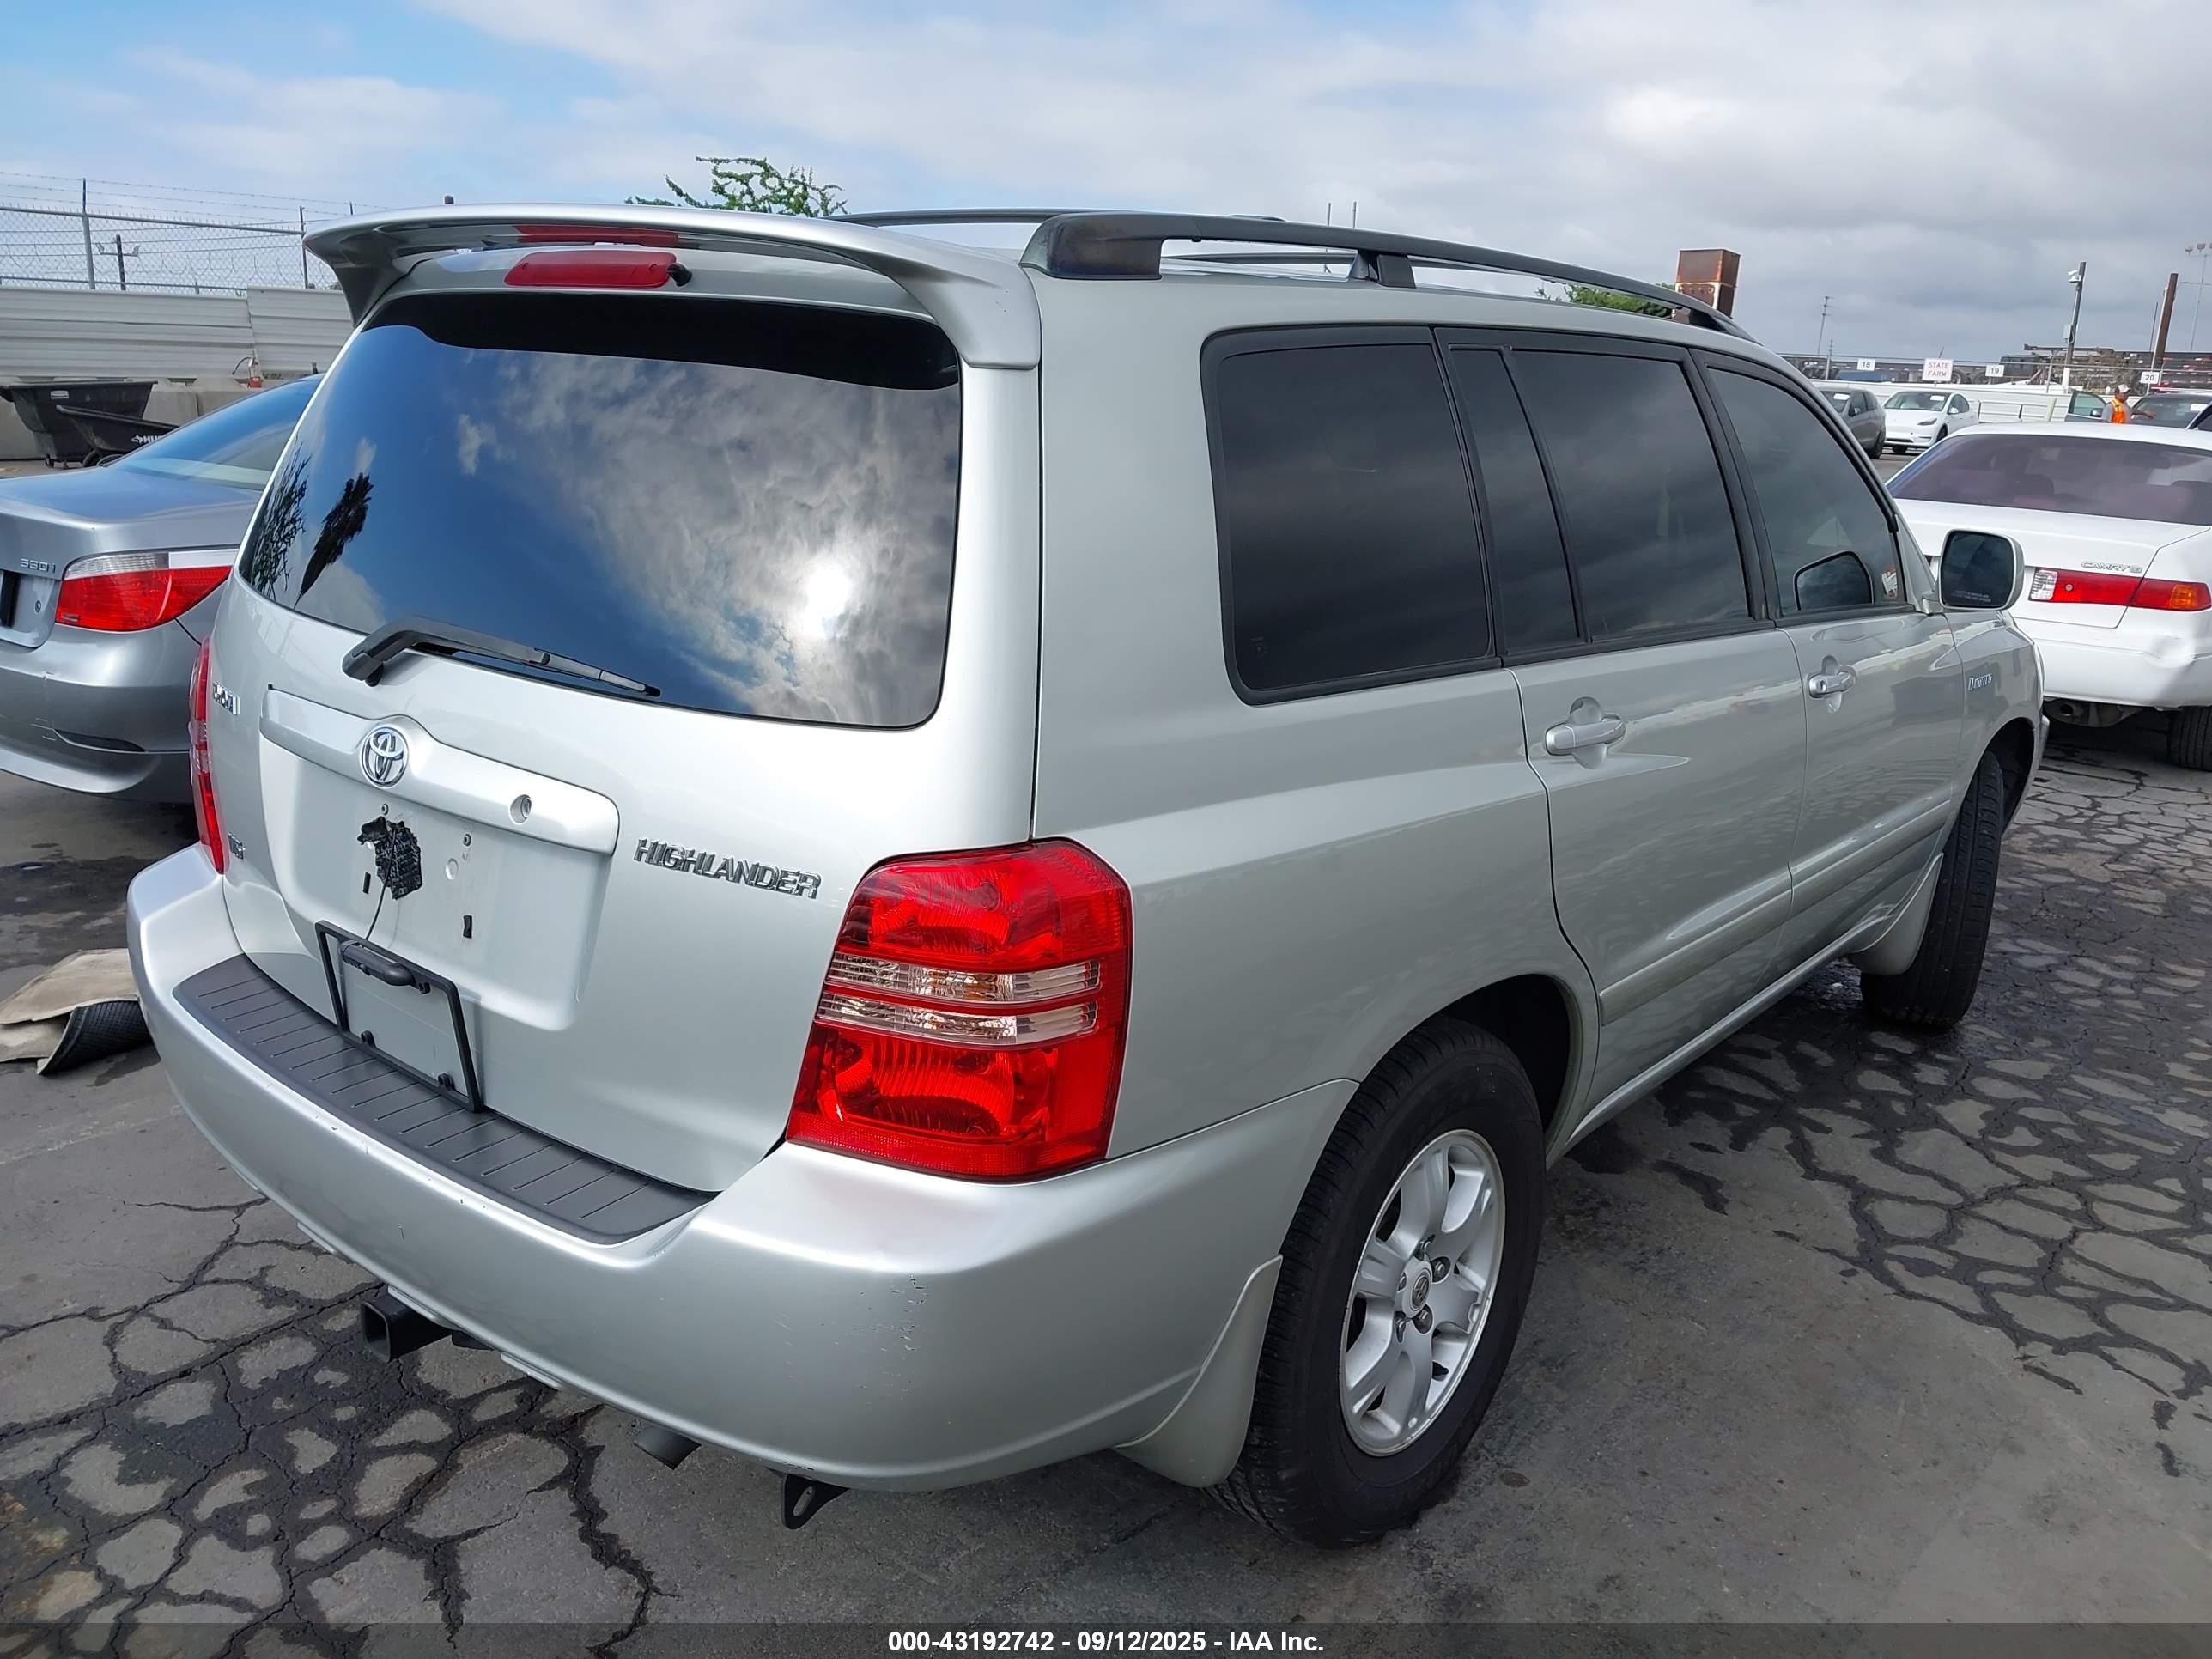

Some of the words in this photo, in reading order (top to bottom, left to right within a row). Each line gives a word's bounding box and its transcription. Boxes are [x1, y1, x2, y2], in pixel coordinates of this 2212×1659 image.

[1928, 362, 1950, 370] STATE
[1990, 367, 2001, 375] 19
[633, 837, 822, 899] HIGHLANDER
